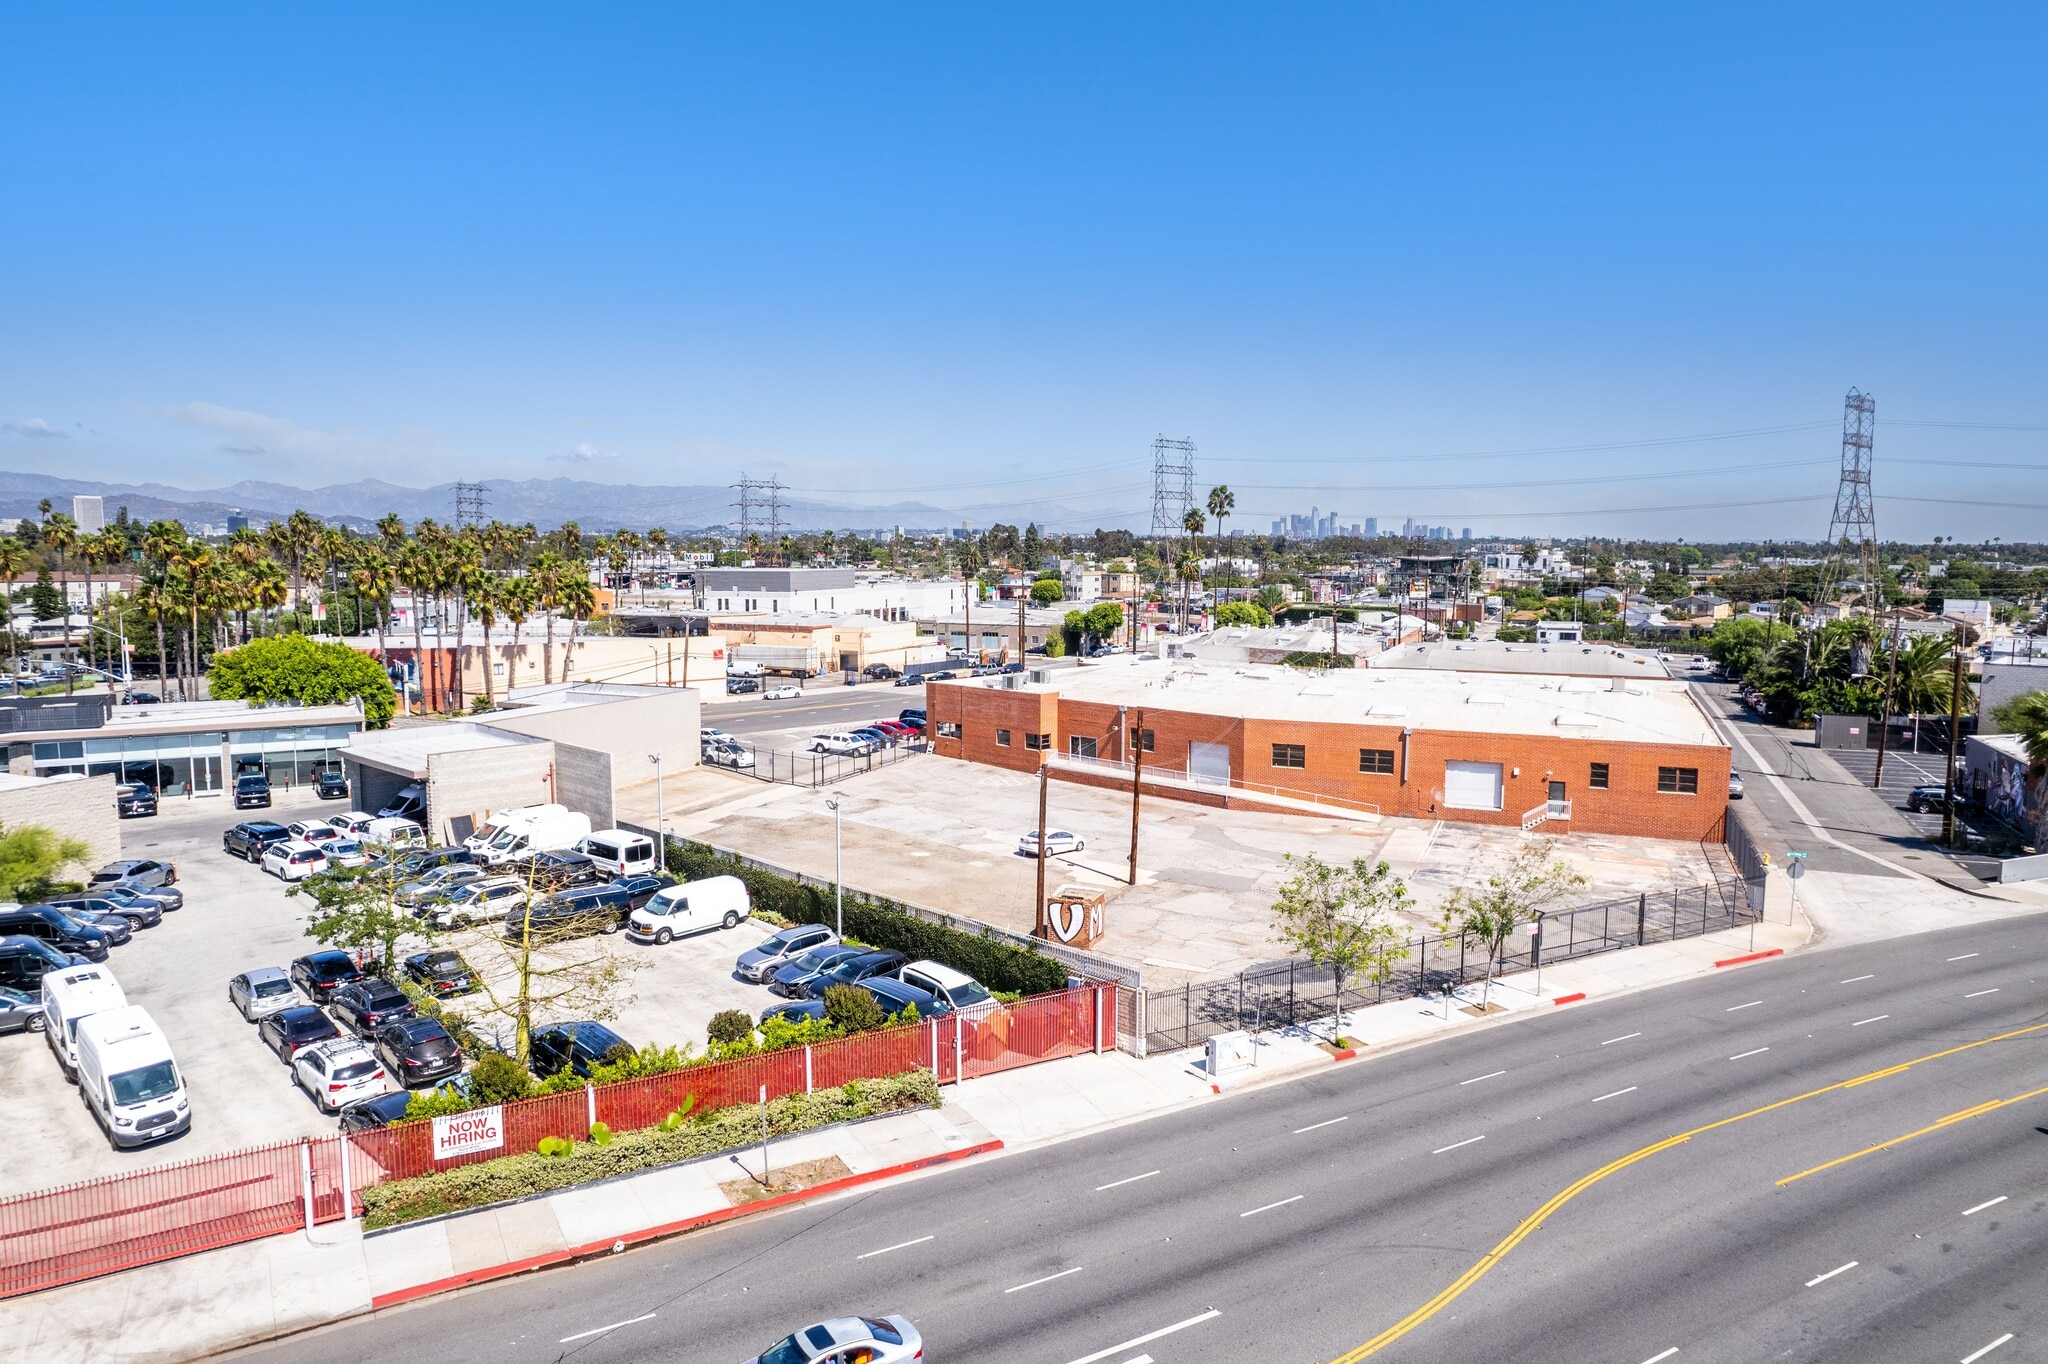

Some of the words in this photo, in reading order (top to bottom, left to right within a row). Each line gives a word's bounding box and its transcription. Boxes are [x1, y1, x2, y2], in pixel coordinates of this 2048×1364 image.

[1048, 902, 1085, 944] V
[1089, 902, 1103, 942] M
[441, 1127, 497, 1148] HIRING
[449, 1117, 488, 1135] NOW
